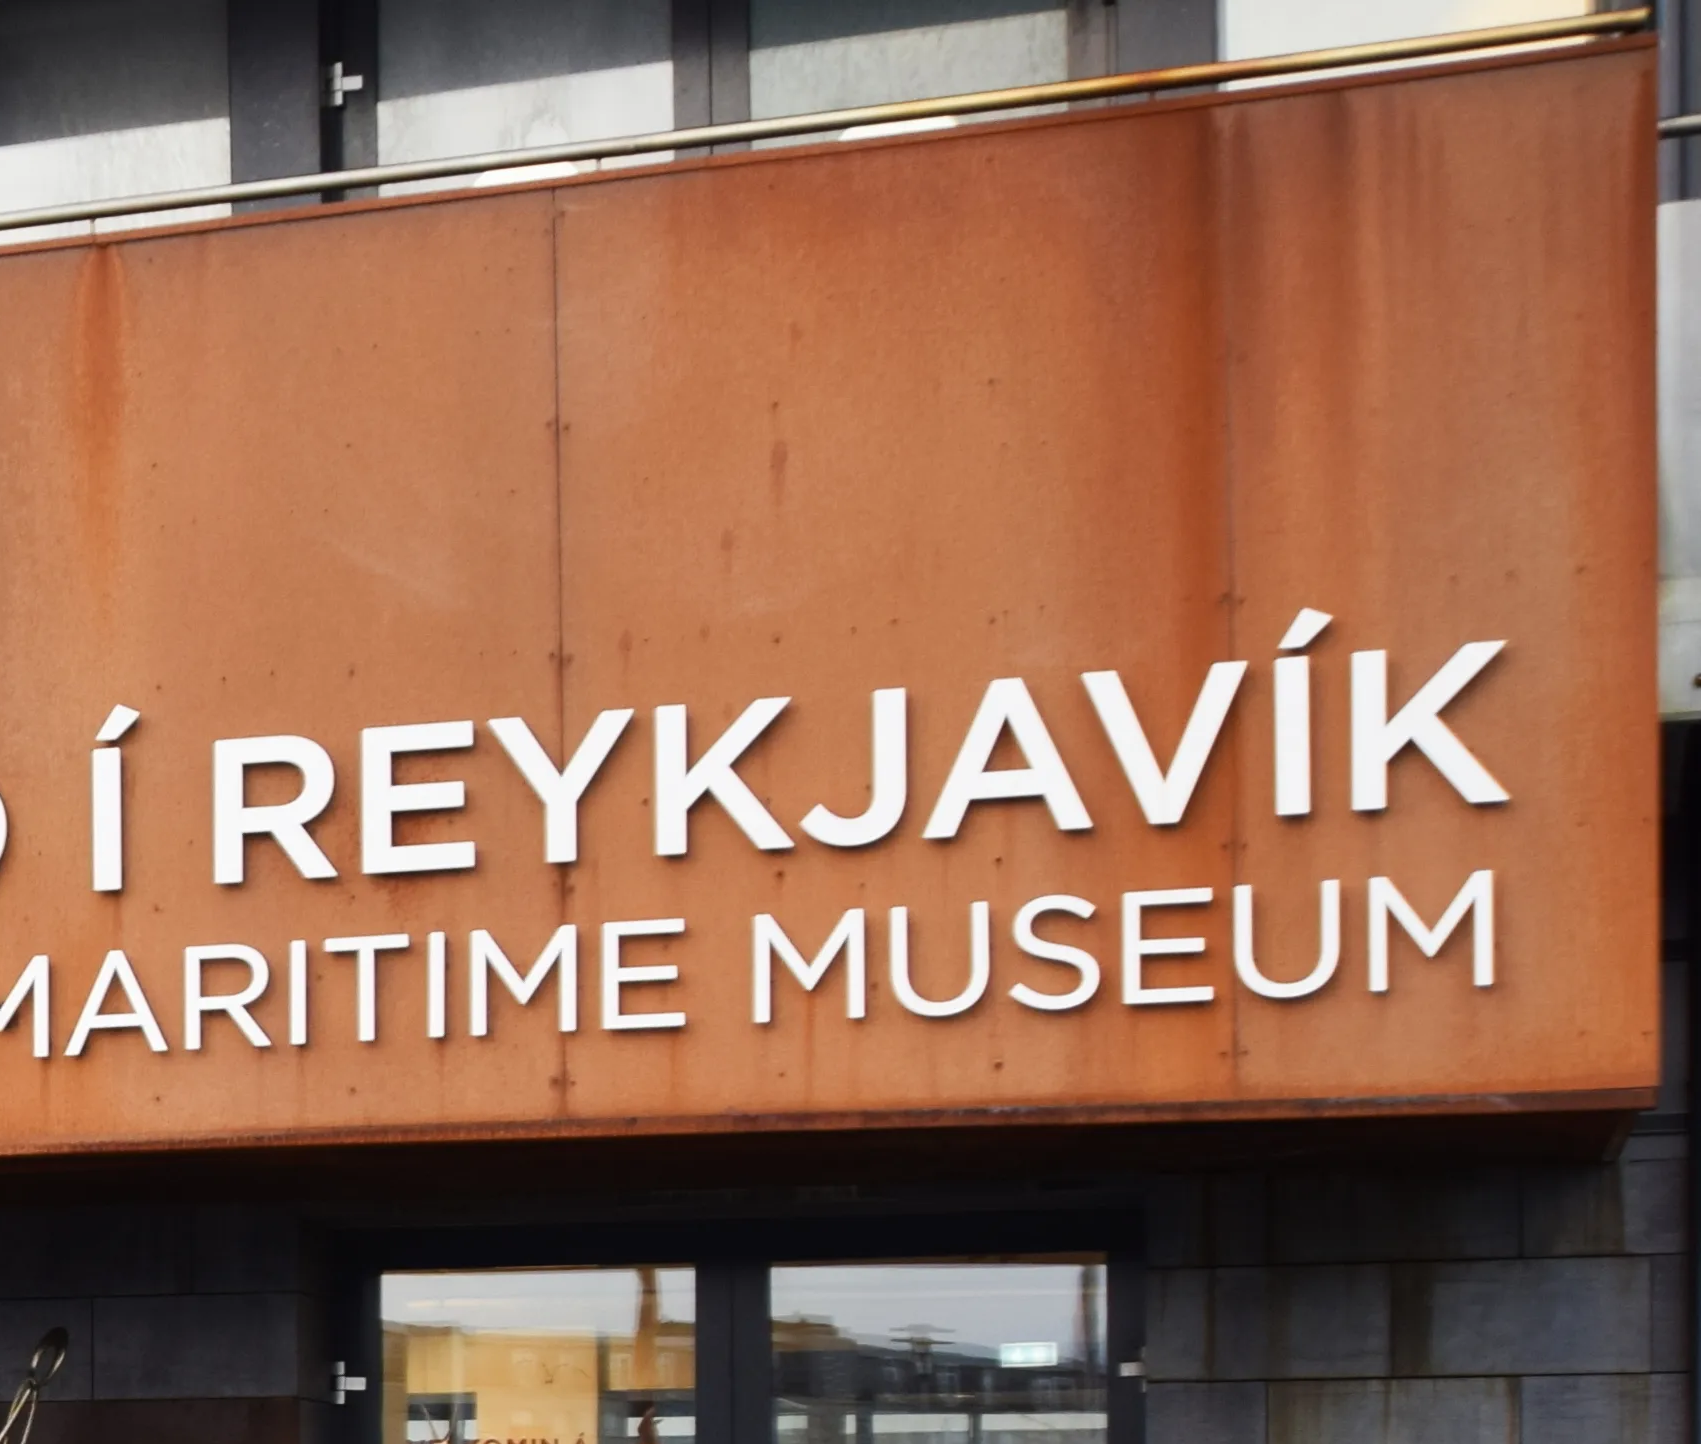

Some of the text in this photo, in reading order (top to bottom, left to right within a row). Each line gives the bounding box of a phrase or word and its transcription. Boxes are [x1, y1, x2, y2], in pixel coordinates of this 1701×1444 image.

[91, 703, 141, 892] Í
[212, 607, 1511, 885] REYKJAVÍK
[752, 869, 1495, 1024] MUSEUM
